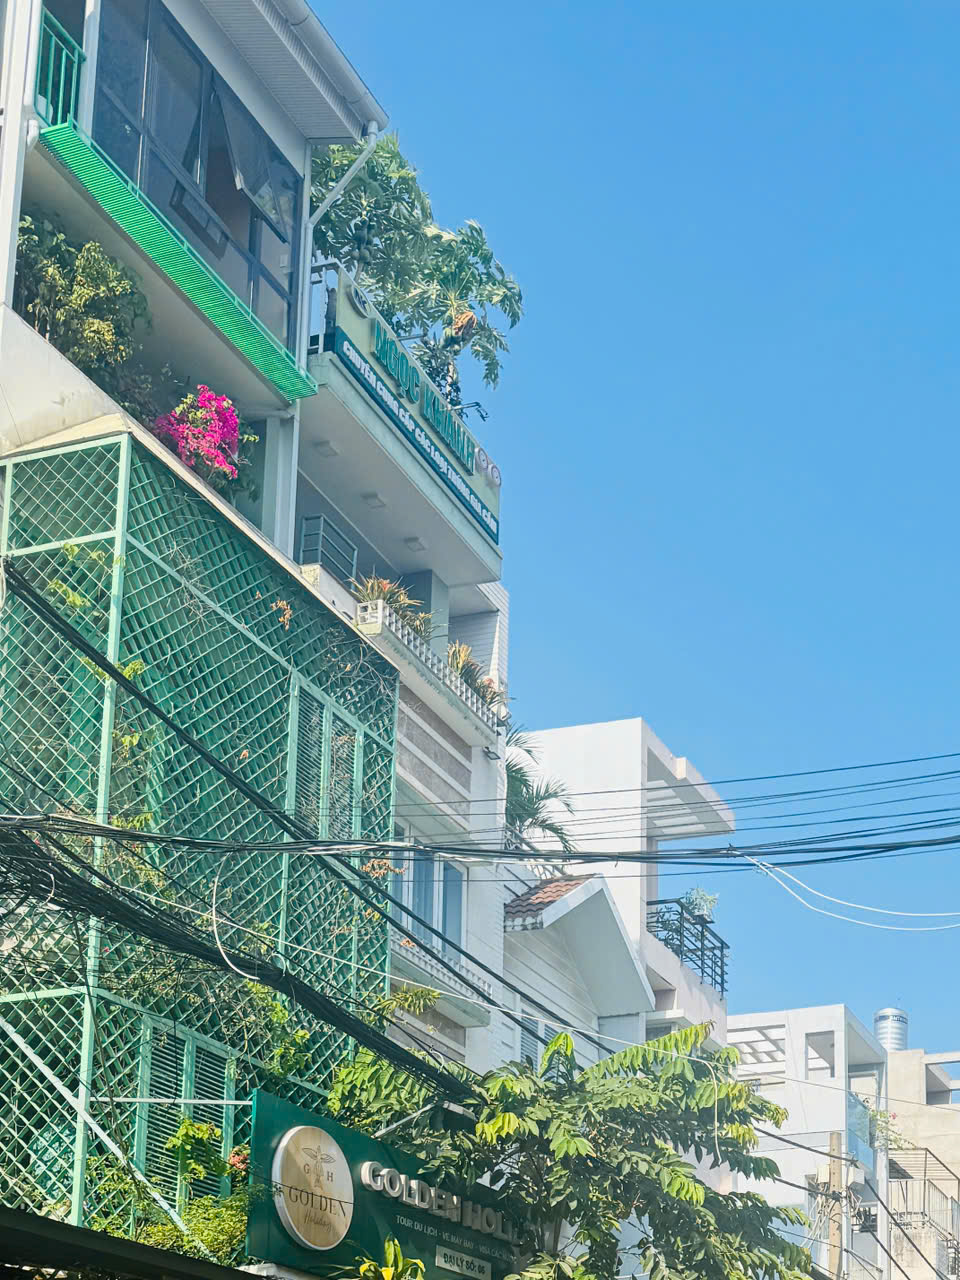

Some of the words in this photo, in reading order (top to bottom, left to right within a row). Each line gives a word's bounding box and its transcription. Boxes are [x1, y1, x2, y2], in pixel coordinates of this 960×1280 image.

[374, 319, 420, 404] NGỌC
[377, 381, 399, 416] CUNG
[303, 1163, 310, 1174] G
[326, 1171, 334, 1182] H
[288, 1186, 346, 1218] GOLDEN
[361, 1161, 462, 1222] GOLDEN
[395, 1215, 413, 1229] TOUR
[414, 1221, 423, 1231] DU
